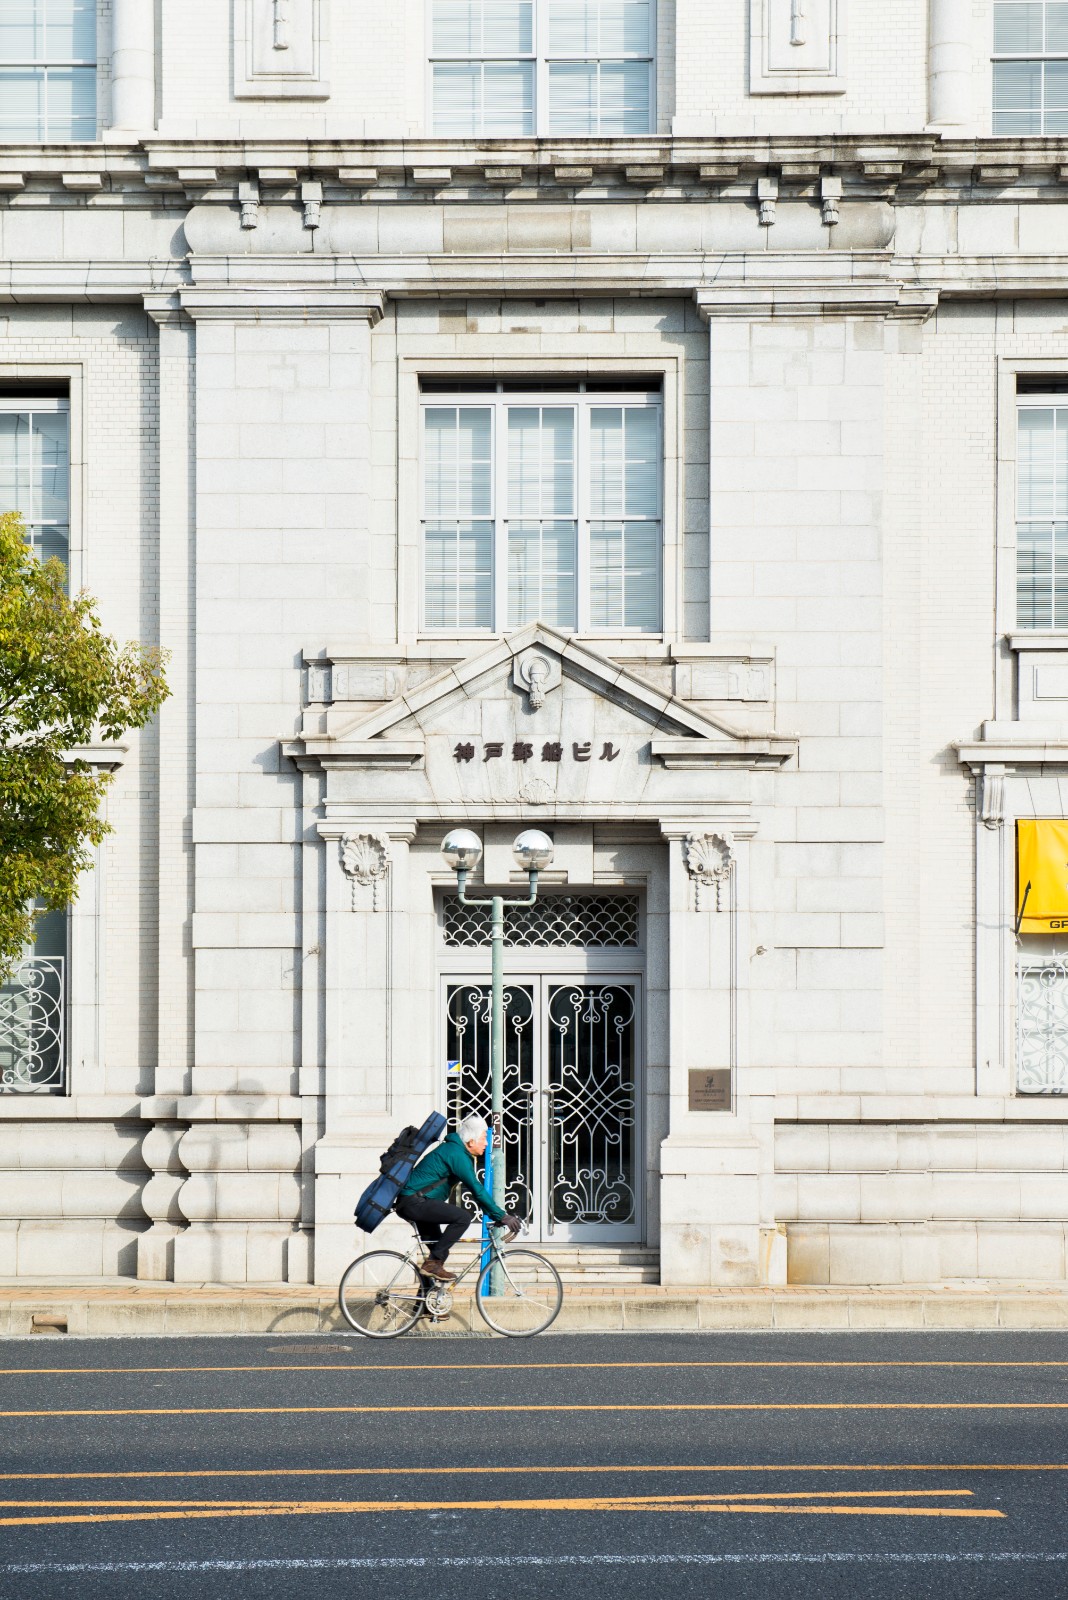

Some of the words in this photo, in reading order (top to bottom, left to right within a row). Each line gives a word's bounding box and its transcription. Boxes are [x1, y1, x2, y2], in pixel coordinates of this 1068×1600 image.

[452, 742, 621, 763] 神戸郵船ビル
